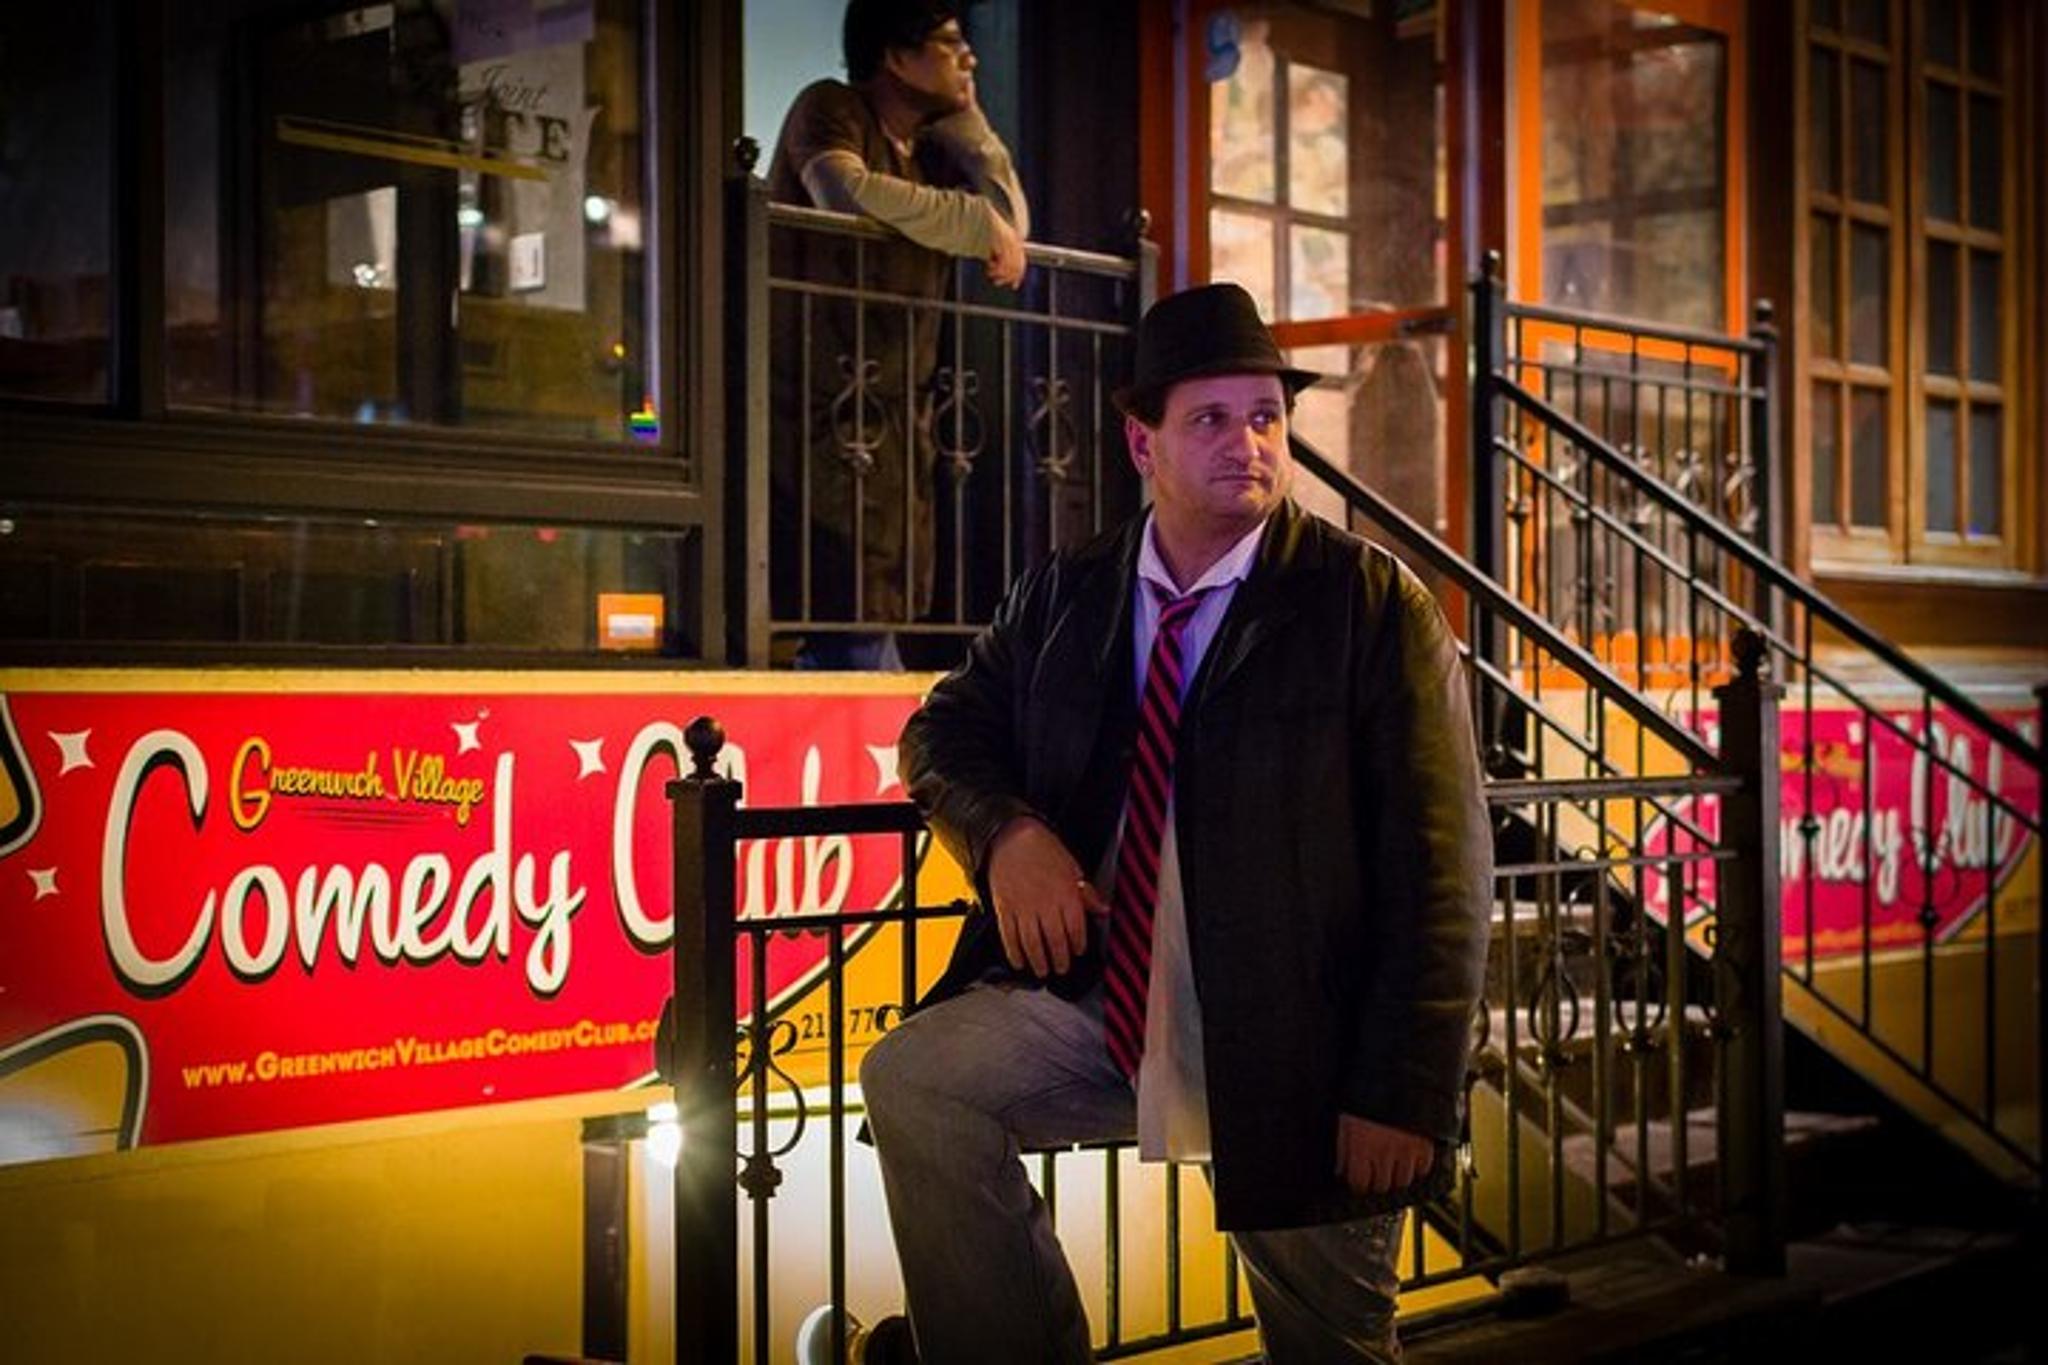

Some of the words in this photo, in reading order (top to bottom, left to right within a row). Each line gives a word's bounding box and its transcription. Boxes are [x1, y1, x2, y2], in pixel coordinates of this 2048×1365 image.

[102, 729, 587, 995] Comedy
[229, 737, 384, 831] Greenwich
[393, 748, 485, 826] Village
[1779, 742, 1902, 905] medy
